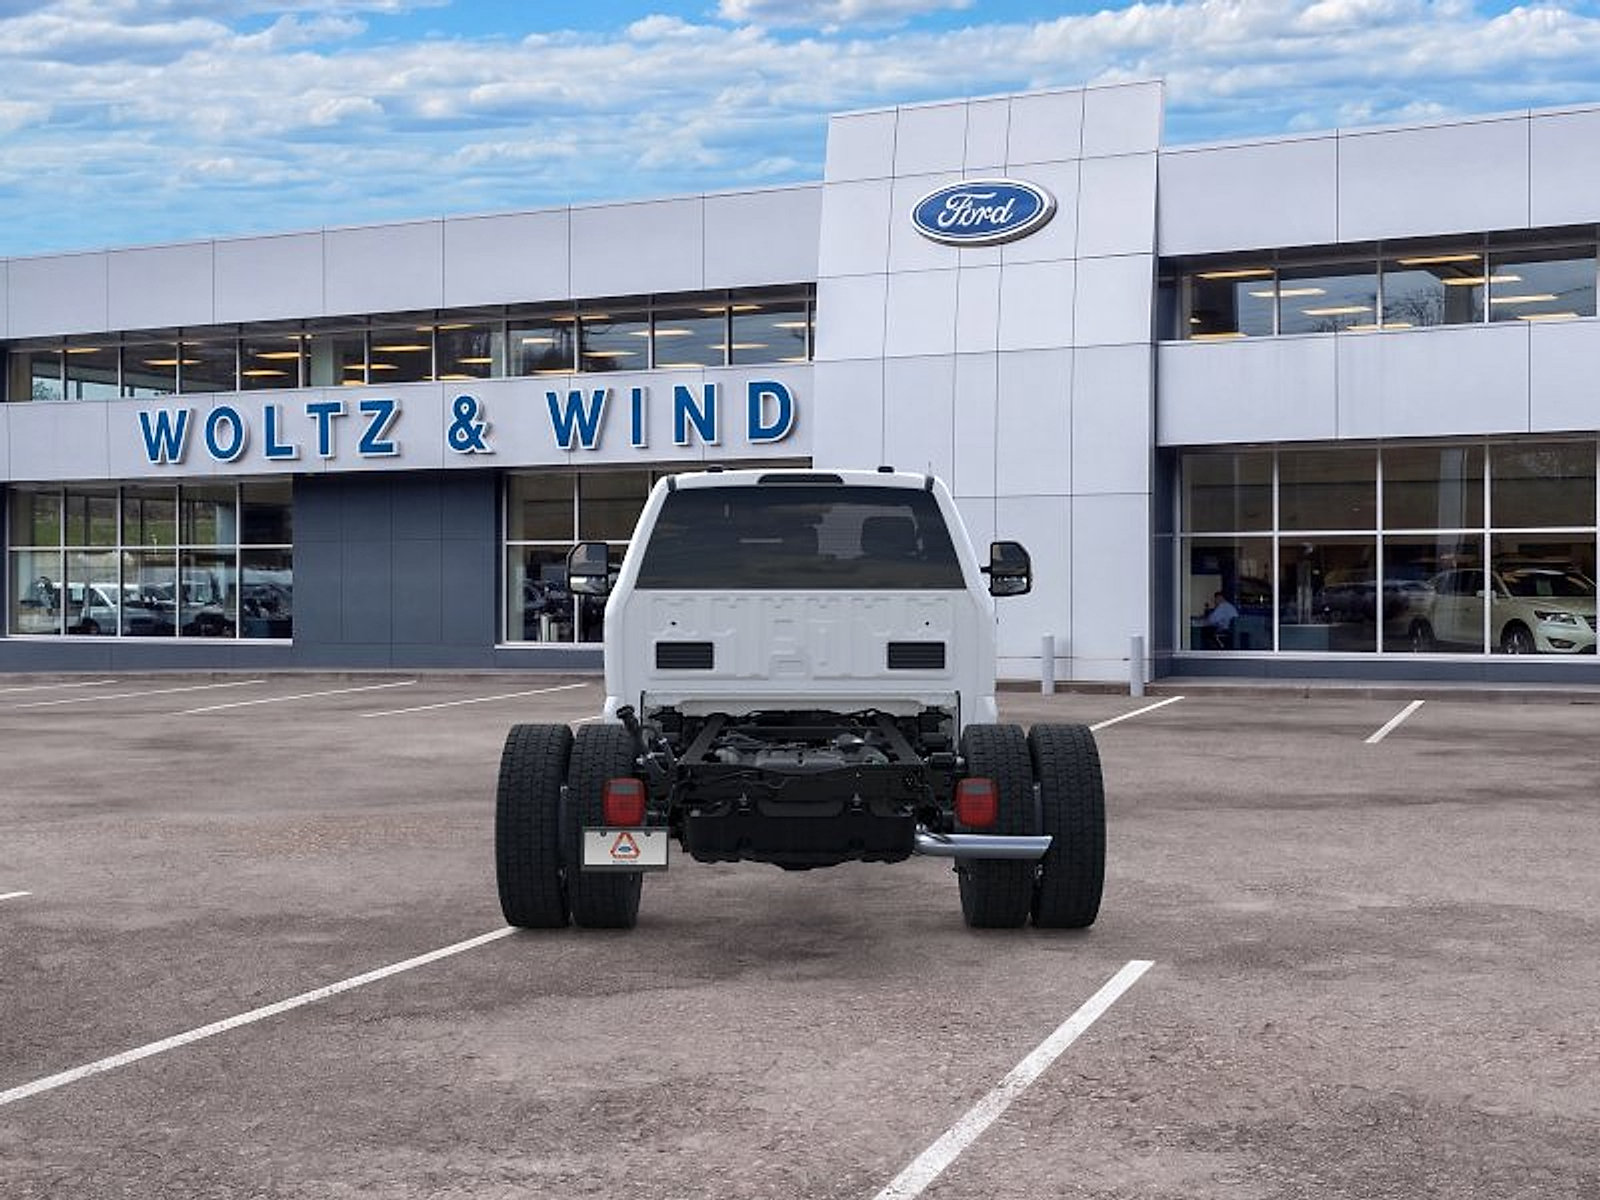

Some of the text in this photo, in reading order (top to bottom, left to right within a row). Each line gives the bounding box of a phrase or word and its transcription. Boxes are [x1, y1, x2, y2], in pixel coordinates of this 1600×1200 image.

[937, 192, 1016, 228] Ford
[138, 380, 797, 464] WOLTZ & WIND
